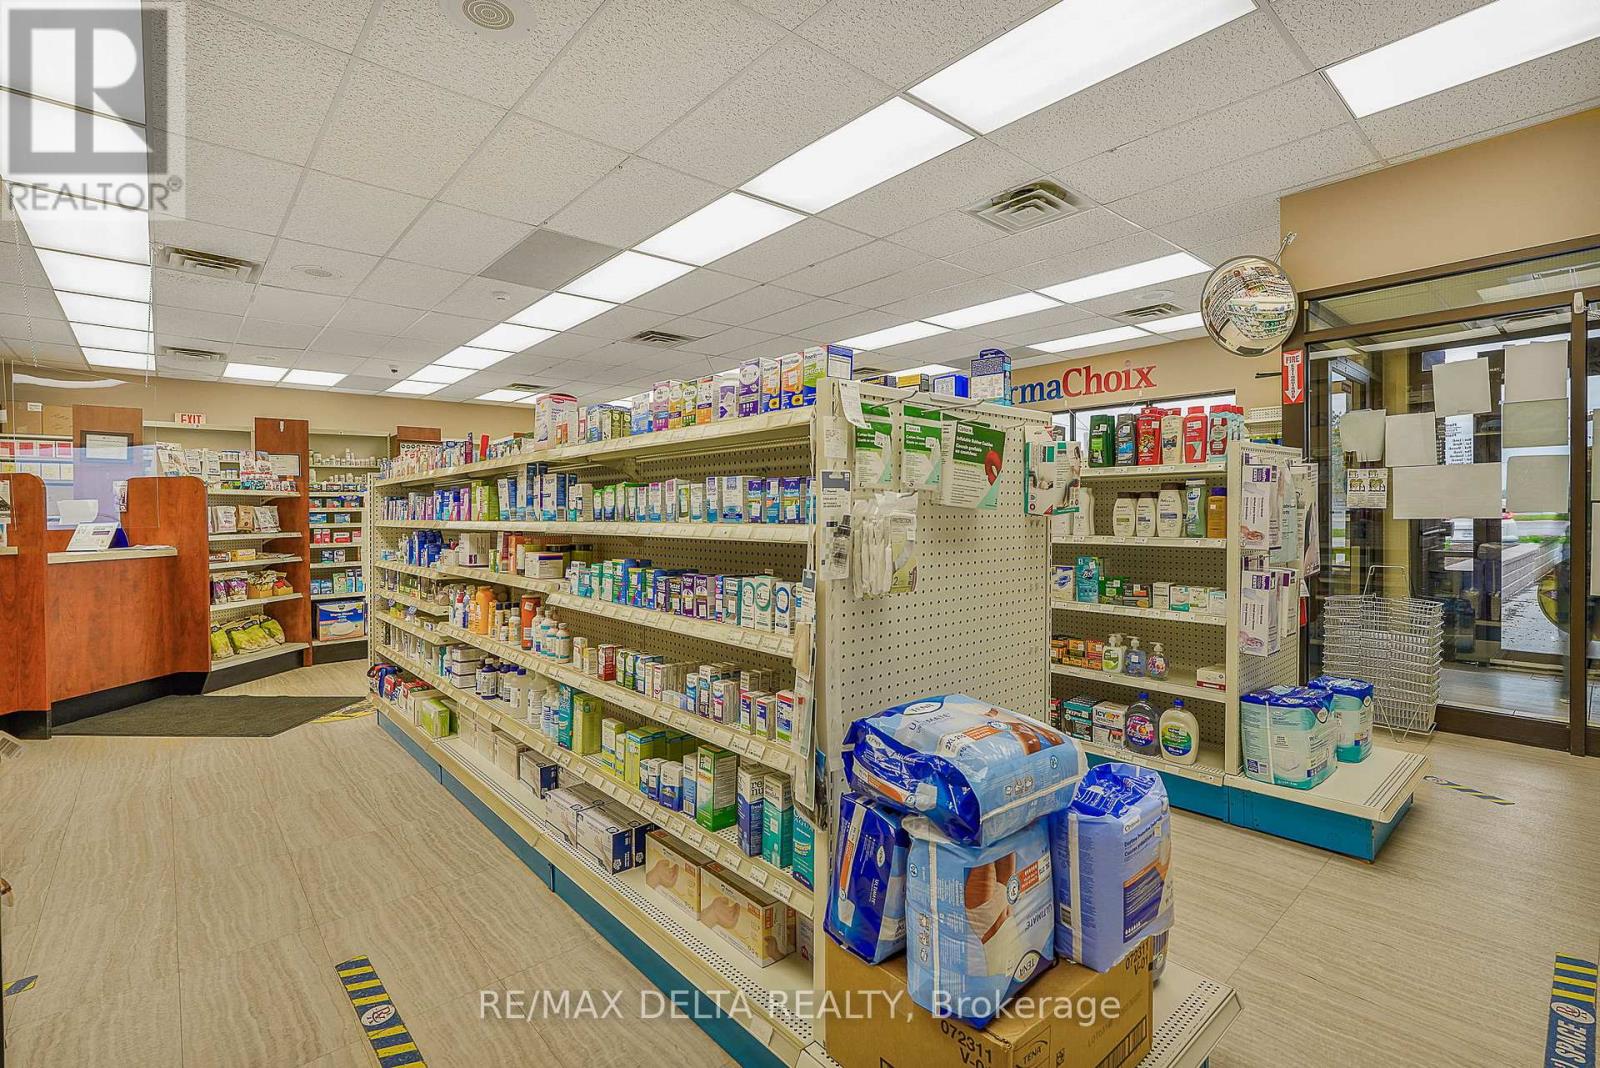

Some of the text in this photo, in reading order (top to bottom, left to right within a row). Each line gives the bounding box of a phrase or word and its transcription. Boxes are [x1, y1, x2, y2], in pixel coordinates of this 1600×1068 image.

[1285, 354, 1300, 364] FIRE
[180, 413, 202, 424] EXIT
[940, 1020, 993, 1063] 072311
[1554, 1019, 1587, 1064] SPACE
[960, 1047, 992, 1068] V-0
